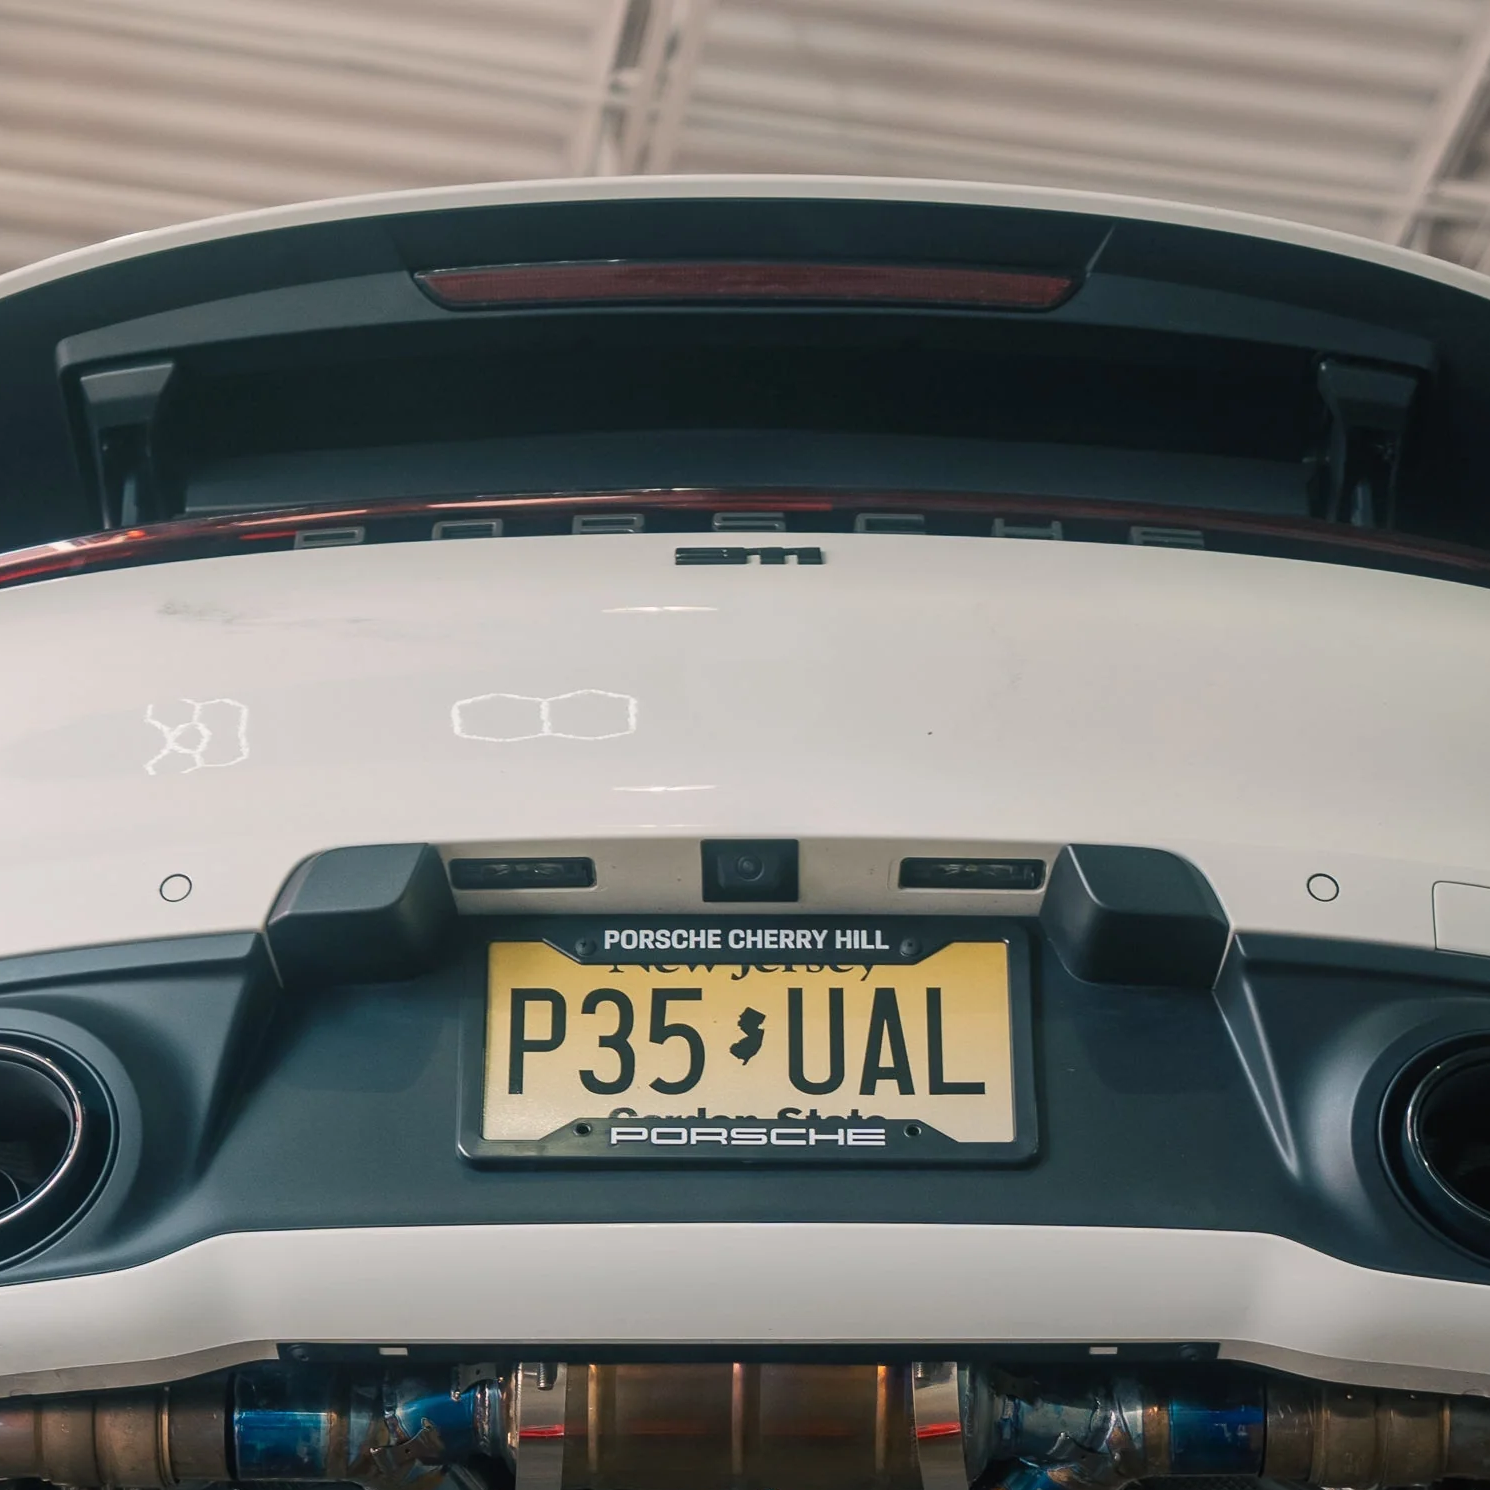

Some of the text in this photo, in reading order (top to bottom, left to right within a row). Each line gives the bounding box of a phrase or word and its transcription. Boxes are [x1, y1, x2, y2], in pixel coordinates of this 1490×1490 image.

[604, 929, 890, 950] PORSCHE CHERRY HILL
[508, 987, 986, 1096] P35 UAL
[610, 1126, 886, 1146] PORSCHE
